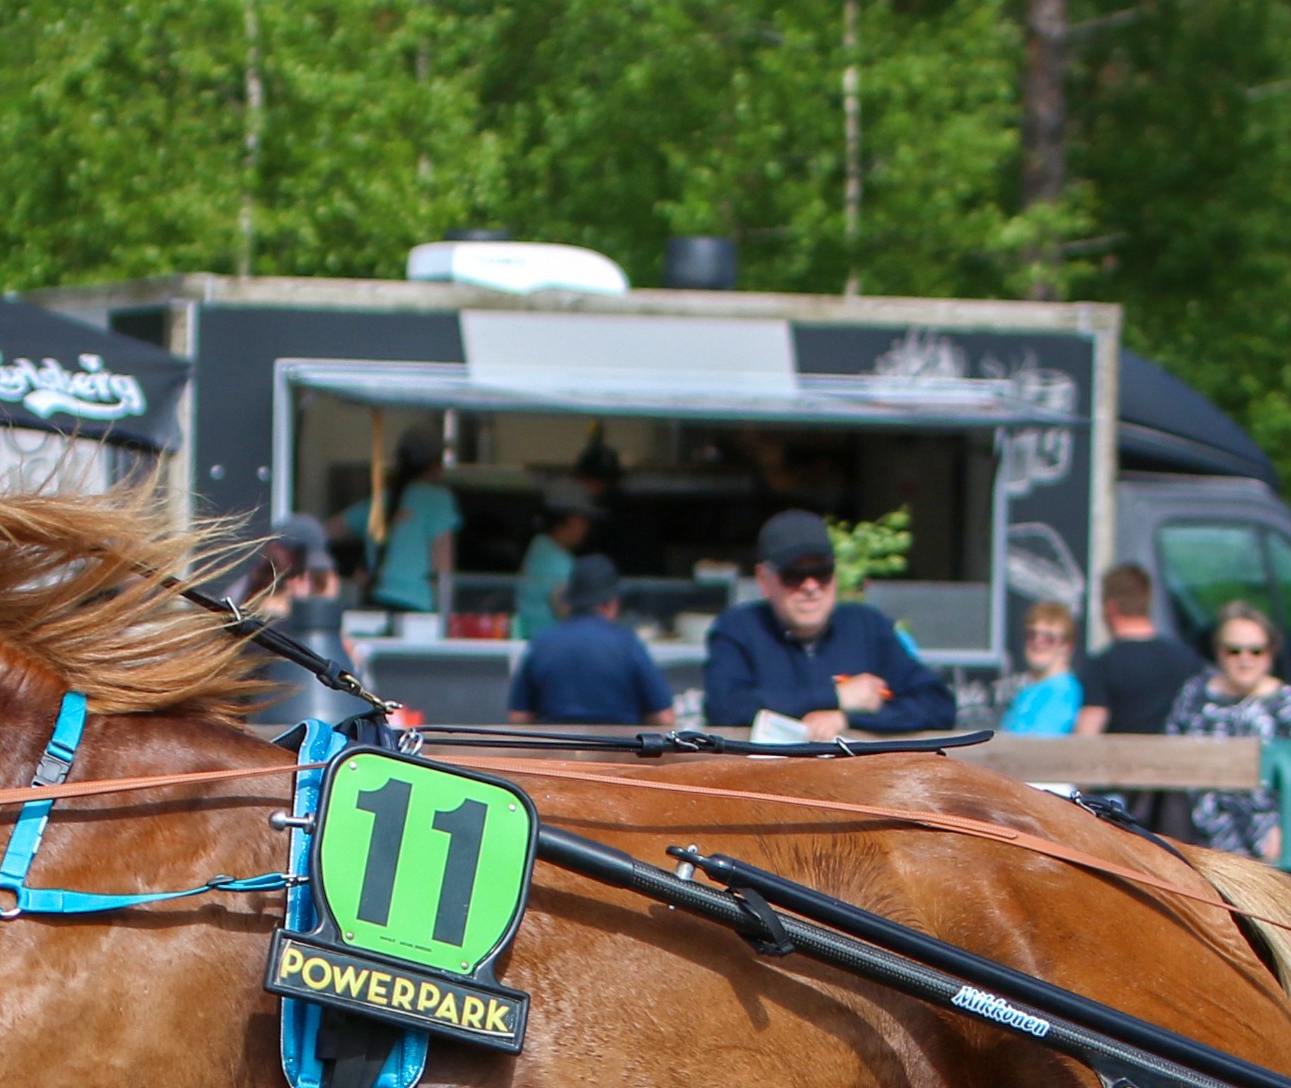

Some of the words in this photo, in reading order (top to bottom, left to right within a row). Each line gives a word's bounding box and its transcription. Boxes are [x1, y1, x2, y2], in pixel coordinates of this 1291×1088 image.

[355, 777, 488, 948] 11
[279, 947, 511, 1032] POWERPARK
[951, 985, 1050, 1037] Mikkonen
